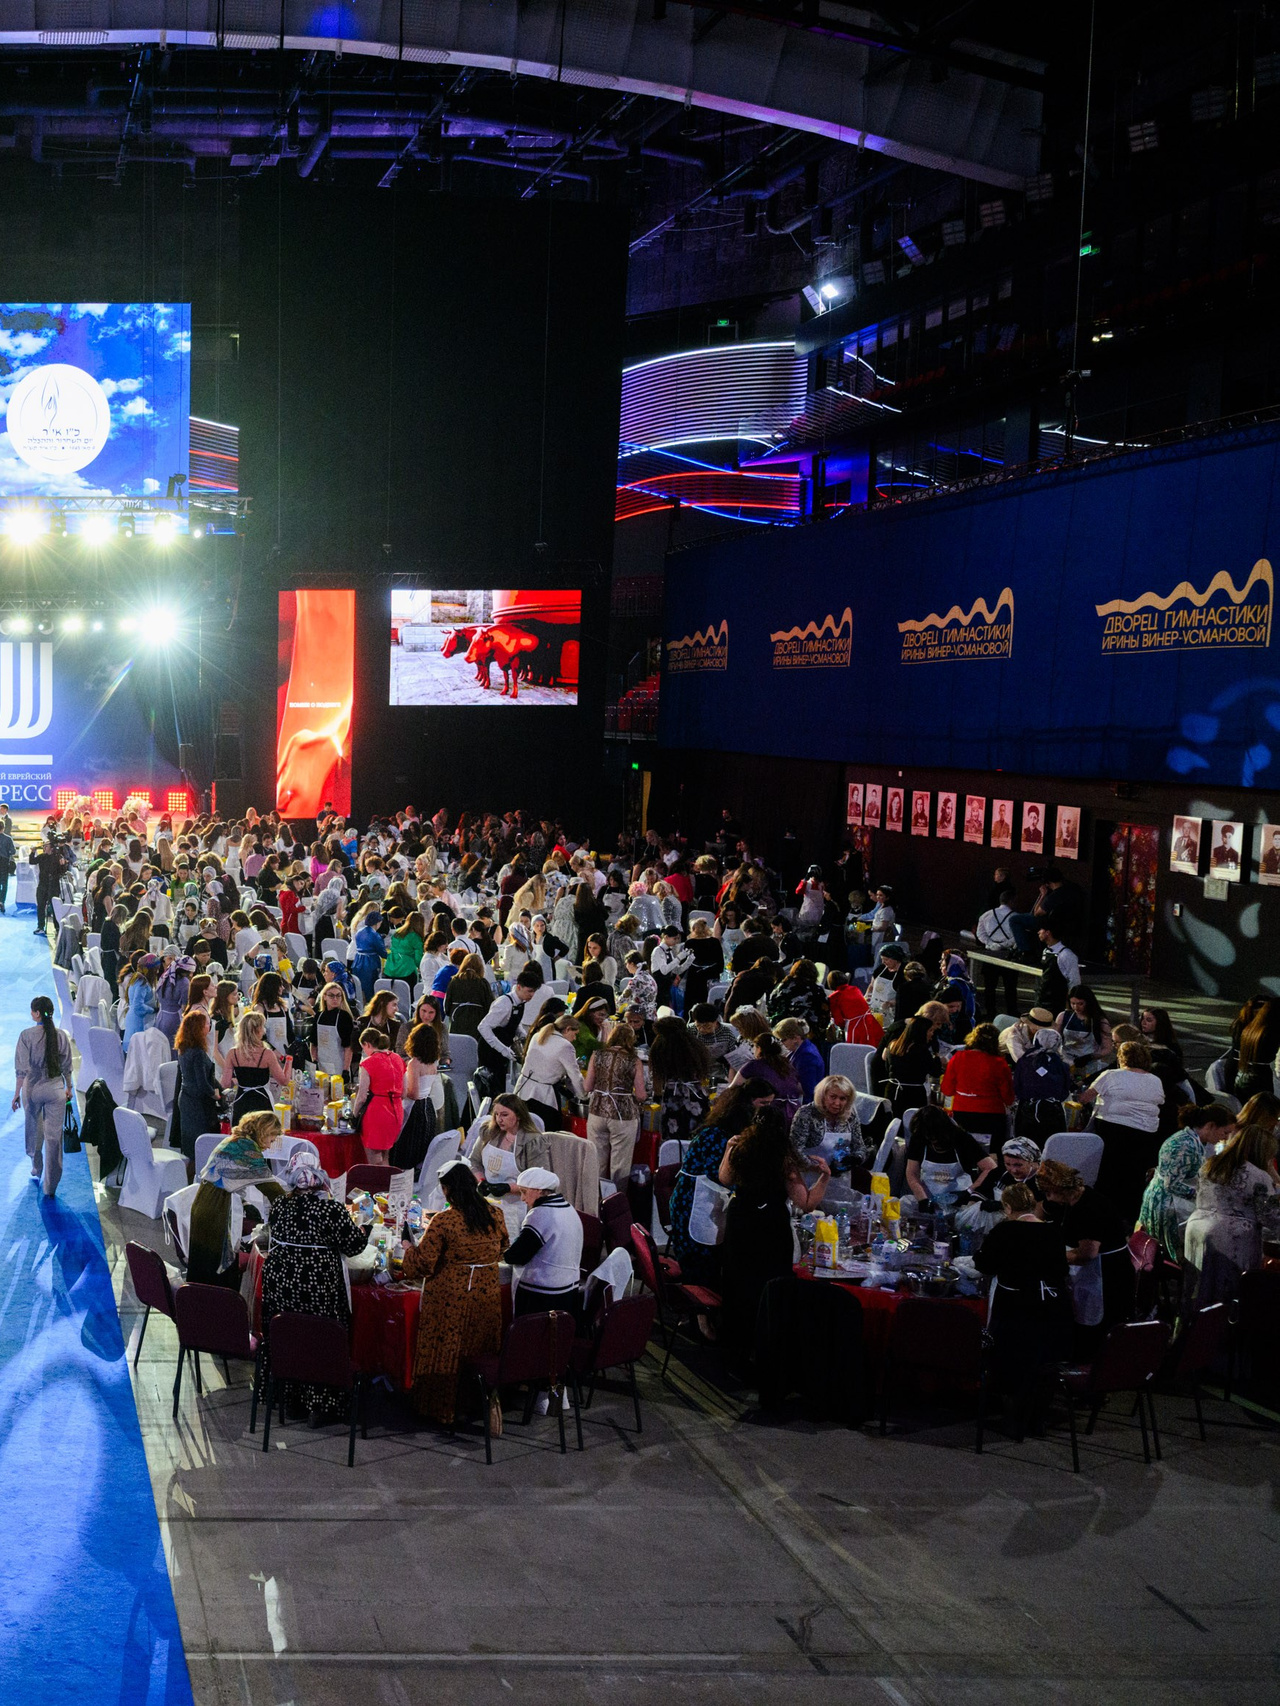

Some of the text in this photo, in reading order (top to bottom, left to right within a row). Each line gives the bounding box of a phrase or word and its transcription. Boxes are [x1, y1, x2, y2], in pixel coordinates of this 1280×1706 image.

[1103, 604, 1269, 635] ДВОРЕЦ ГИМНАСТИКИ
[774, 637, 850, 655] ДВОРЕЦ ГИМНАСТИКИ
[903, 624, 1011, 648] ДВОРЕЦ ГИМНАСТИКИ
[1101, 624, 1267, 651] ИРИНЫ ВИНЕР-УСМАНОВОЙ
[901, 639, 1009, 660] ИРИНЫ ВИНЕР-УСМАНОВОЙ
[8, 772, 52, 780] ЕВРЕЙСКИЙ
